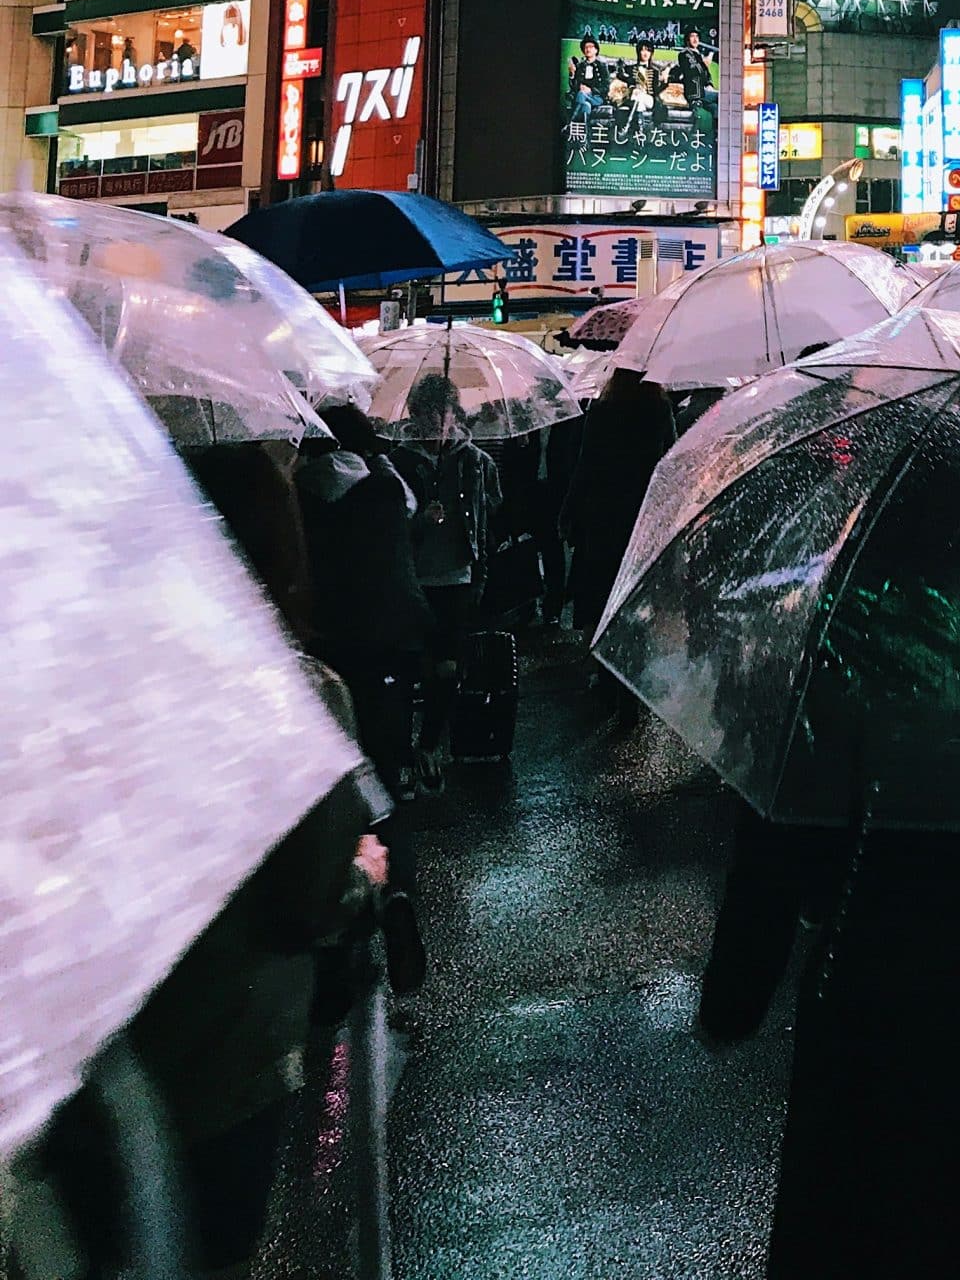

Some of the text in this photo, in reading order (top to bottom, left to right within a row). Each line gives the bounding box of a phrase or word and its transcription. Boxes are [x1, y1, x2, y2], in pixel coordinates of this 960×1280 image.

[759, 8, 784, 18] 2468
[69, 58, 193, 92] Euphoria
[202, 119, 242, 156] JTB
[567, 121, 713, 149] 馬主じゃないよ、
